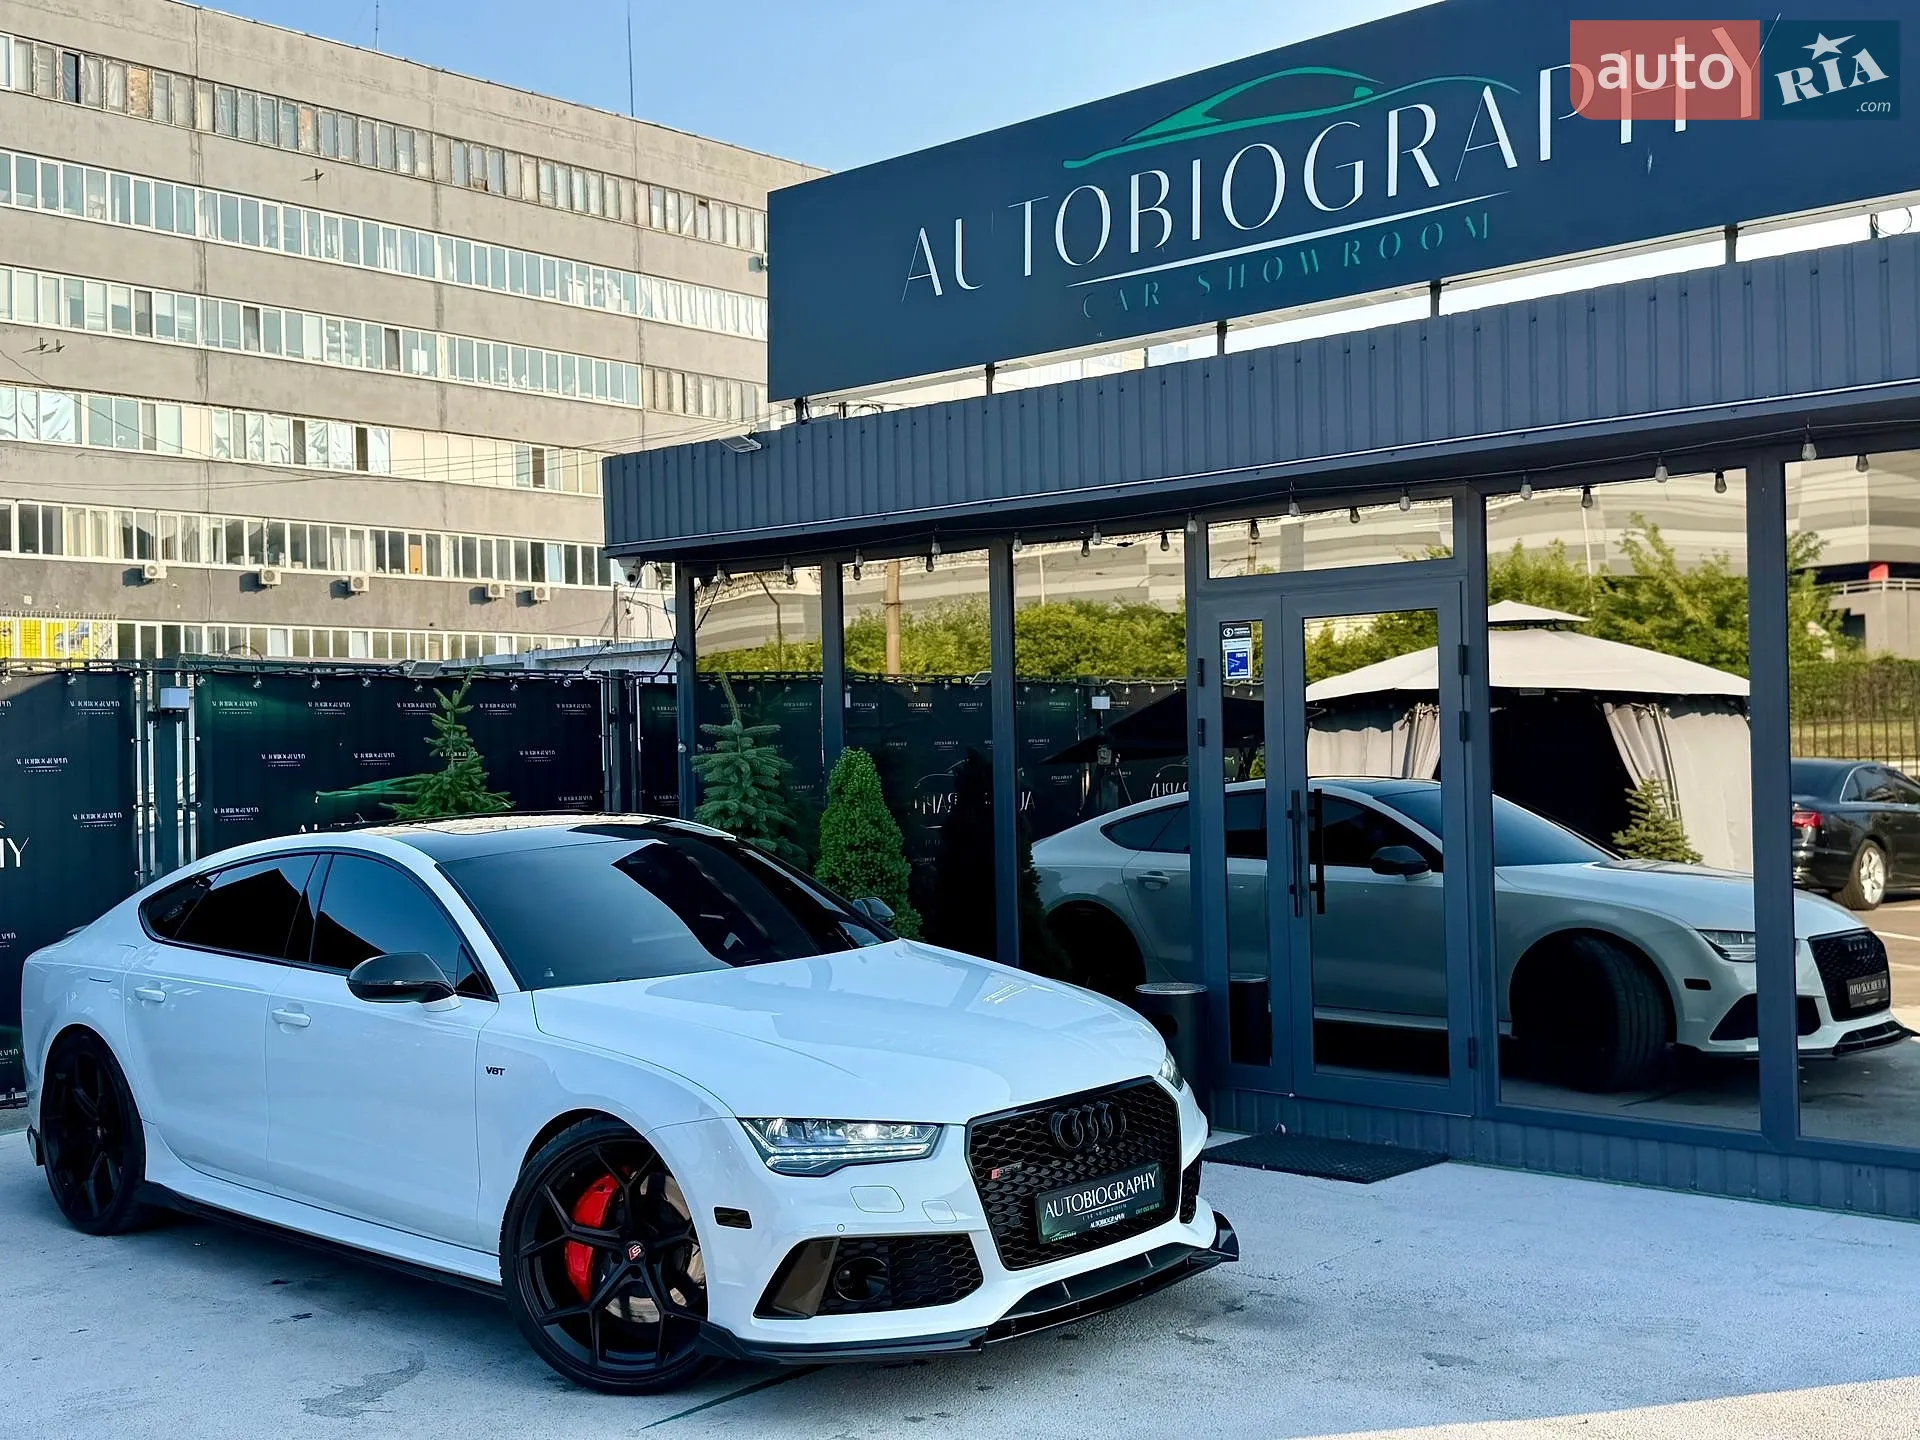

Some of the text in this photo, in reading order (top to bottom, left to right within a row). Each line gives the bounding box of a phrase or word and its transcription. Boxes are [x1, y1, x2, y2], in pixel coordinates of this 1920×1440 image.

[901, 13, 1781, 304] AUTOBIOGRAPHY
[1082, 212, 1488, 318] CAR SHOWROOM
[485, 1066, 506, 1076] V8T
[1044, 1170, 1157, 1220] AUTOBIOGRAPHY
